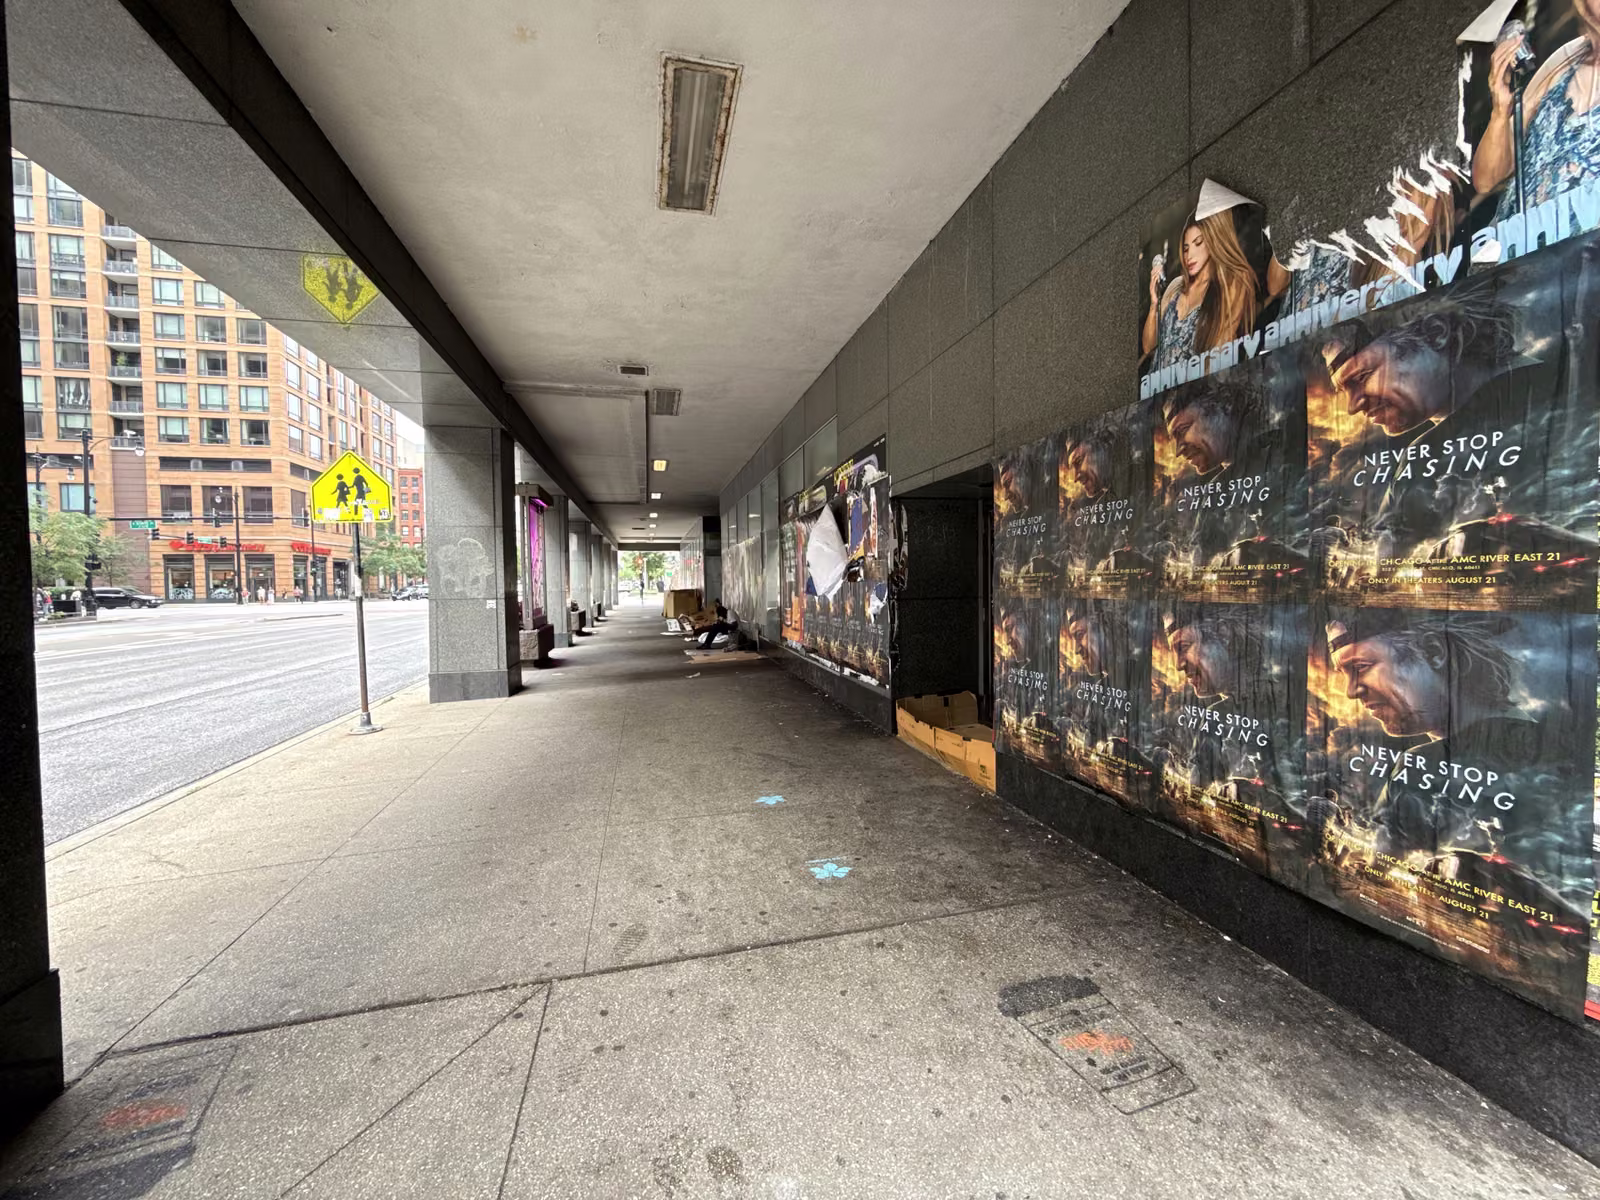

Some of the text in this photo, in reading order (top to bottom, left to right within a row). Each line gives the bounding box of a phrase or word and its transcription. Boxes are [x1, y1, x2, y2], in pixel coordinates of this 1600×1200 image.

[1364, 431, 1504, 468] NEVER STOP
[1353, 446, 1522, 487] CHASING
[1184, 475, 1261, 497] NEVER STOP
[1079, 499, 1129, 516] NEVER STOP
[1177, 487, 1271, 512] CHASING
[1027, 515, 1043, 525] STOP
[1074, 508, 1134, 527] CHASING
[1006, 523, 1047, 537] CHASING
[1380, 557, 1423, 566] CHCAGO
[1450, 555, 1477, 563] AMC
[1480, 554, 1510, 562] RIVER
[1514, 553, 1543, 561] EAST
[1547, 552, 1560, 561] 21
[1445, 576, 1482, 584] AUGUST
[1485, 576, 1496, 584] 21
[1030, 671, 1044, 680] STOP
[1076, 689, 1132, 712] CHASING
[1079, 681, 1128, 699] NEVER STOP
[1184, 705, 1259, 730] NEVER STOP
[1177, 714, 1269, 747] CHASING
[1362, 743, 1499, 786] NEVER STOP
[1349, 756, 1516, 810] CHASING
[1262, 810, 1279, 820] EAST
[1280, 815, 1288, 823] 21
[1364, 865, 1384, 877] ONLY
[1439, 895, 1477, 913] AUGUST
[1479, 910, 1489, 919] 21
[1376, 851, 1418, 872] CHICAGO
[1444, 878, 1471, 892] AMC
[1474, 886, 1504, 904] RIVER
[1508, 899, 1537, 916] EAST
[1540, 911, 1554, 922] 21
